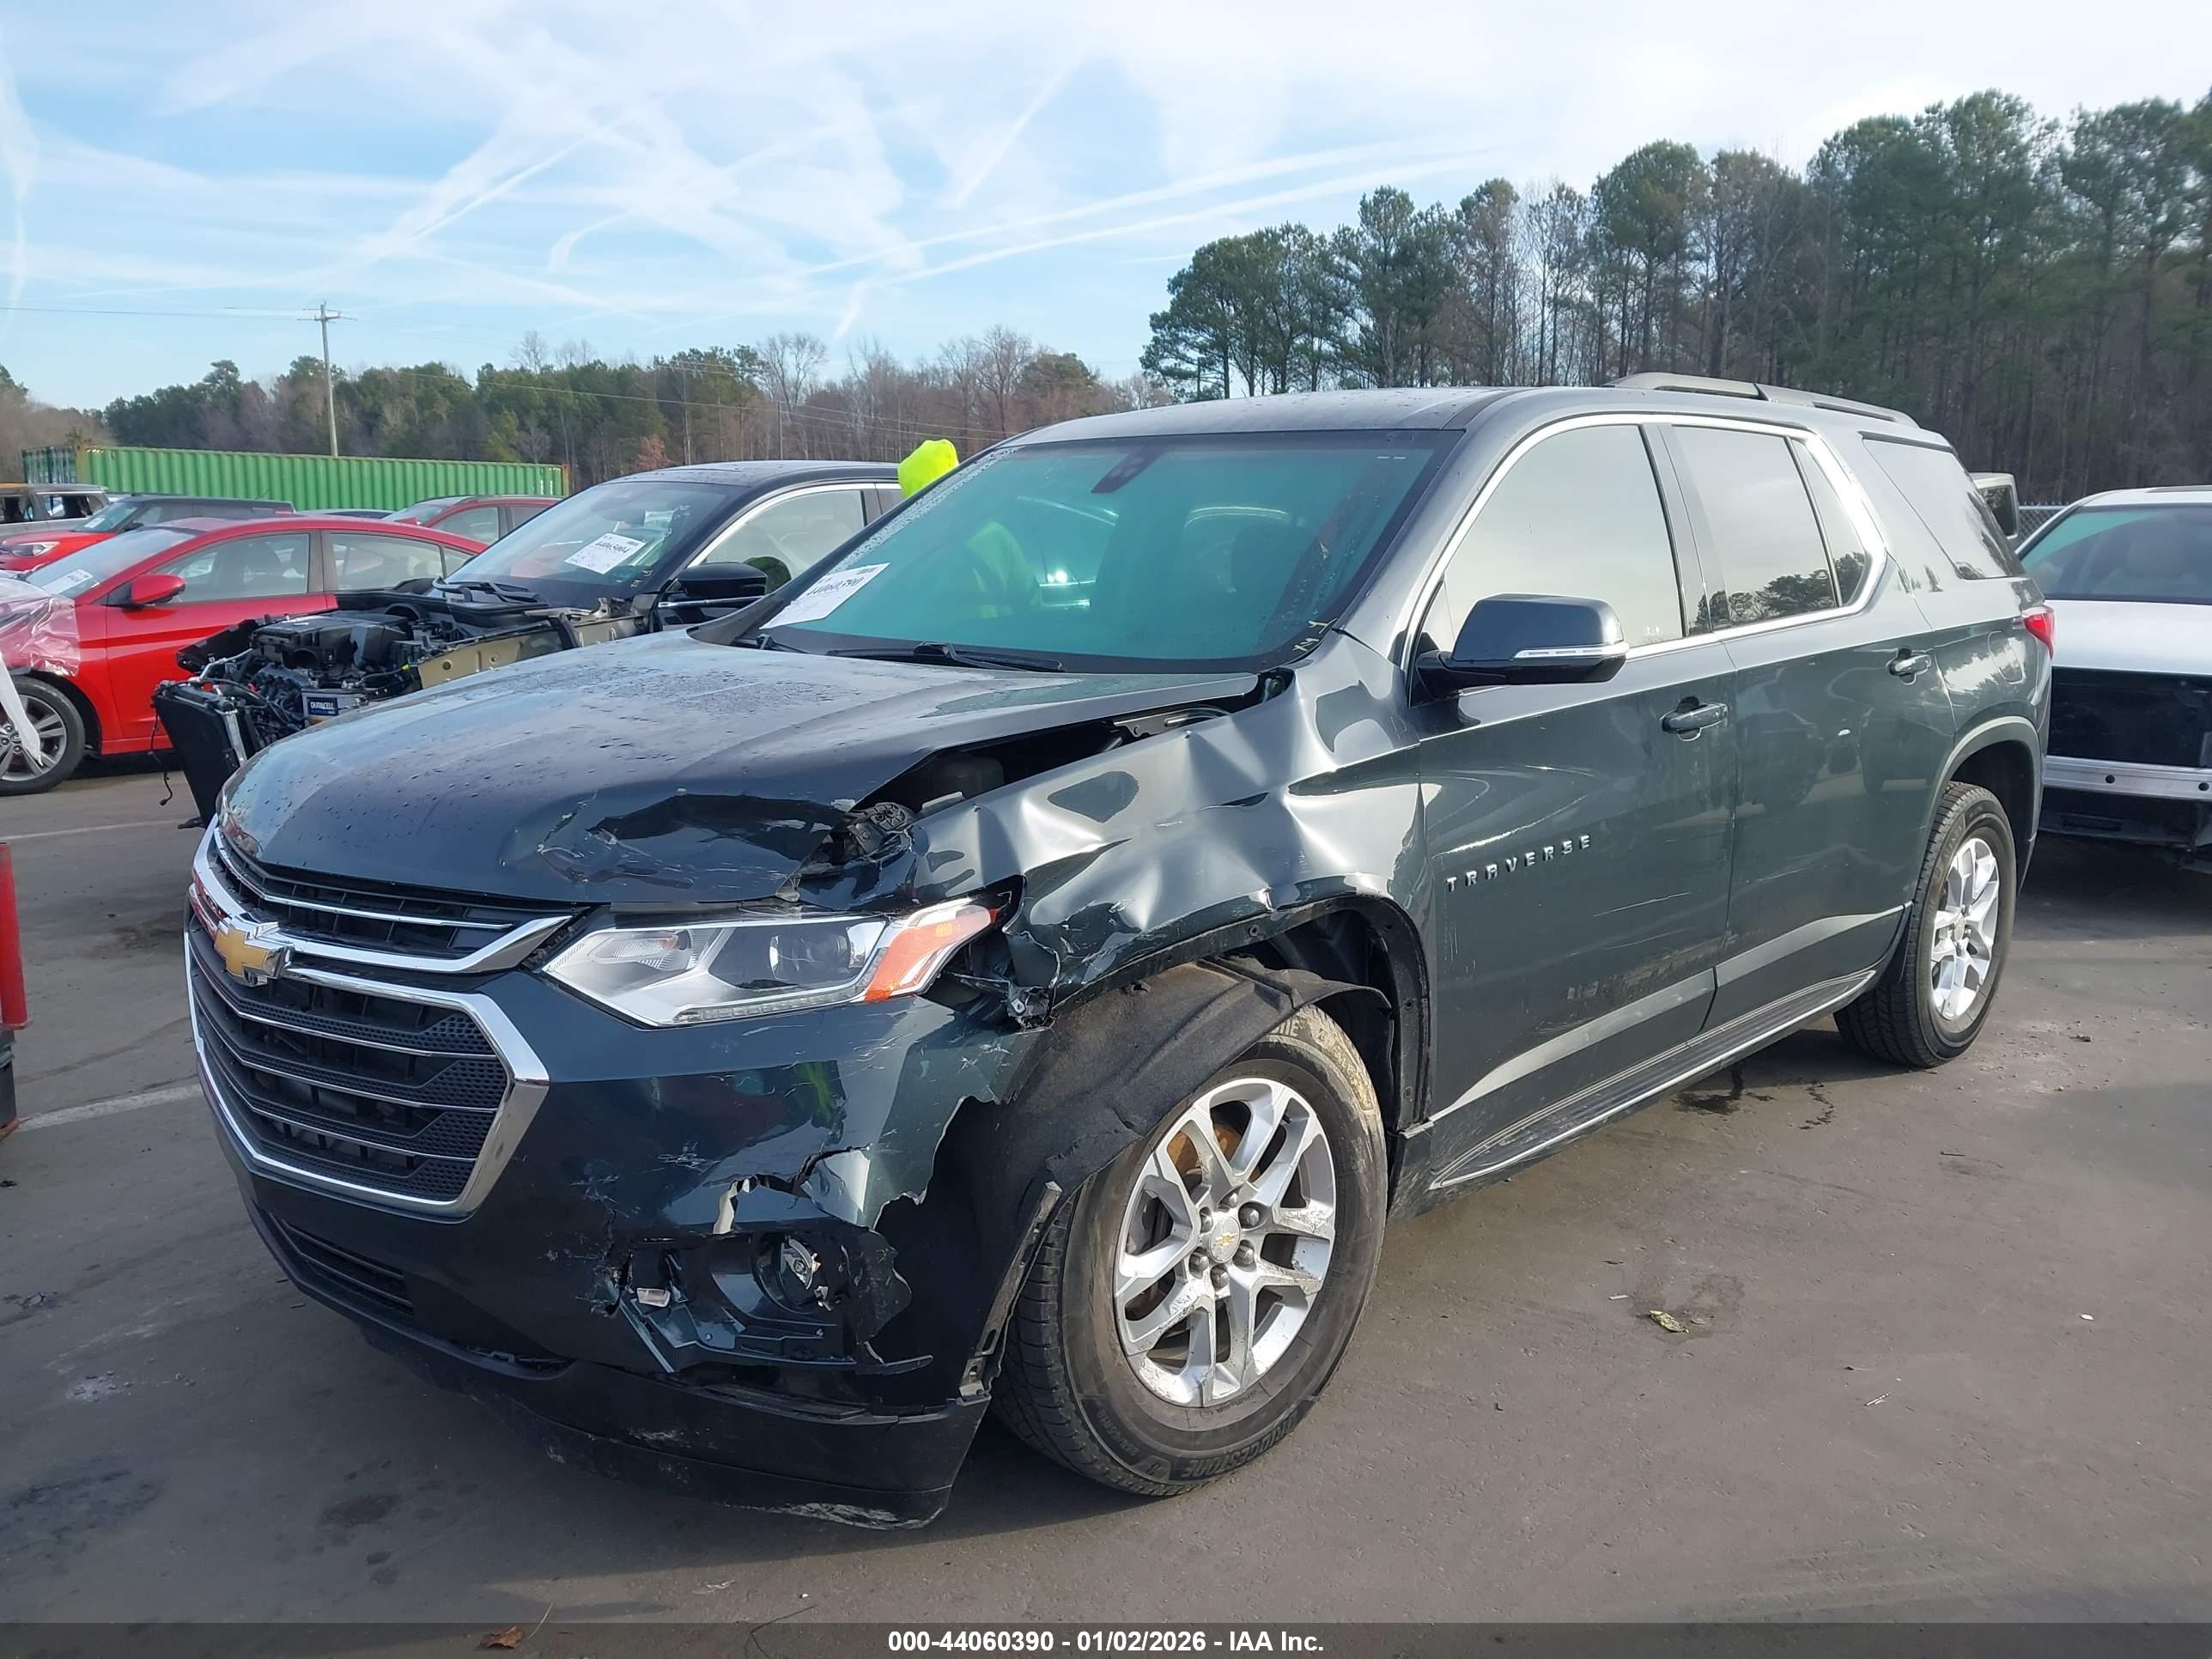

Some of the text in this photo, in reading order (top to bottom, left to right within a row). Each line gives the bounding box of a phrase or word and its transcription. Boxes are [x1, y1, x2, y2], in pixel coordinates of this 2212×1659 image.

[806, 576, 865, 596] 44060390
[310, 701, 335, 710] DURACELL
[1446, 835, 1591, 892] TRAVERSE
[1181, 1411, 1298, 1478] BRIDGESTONE
